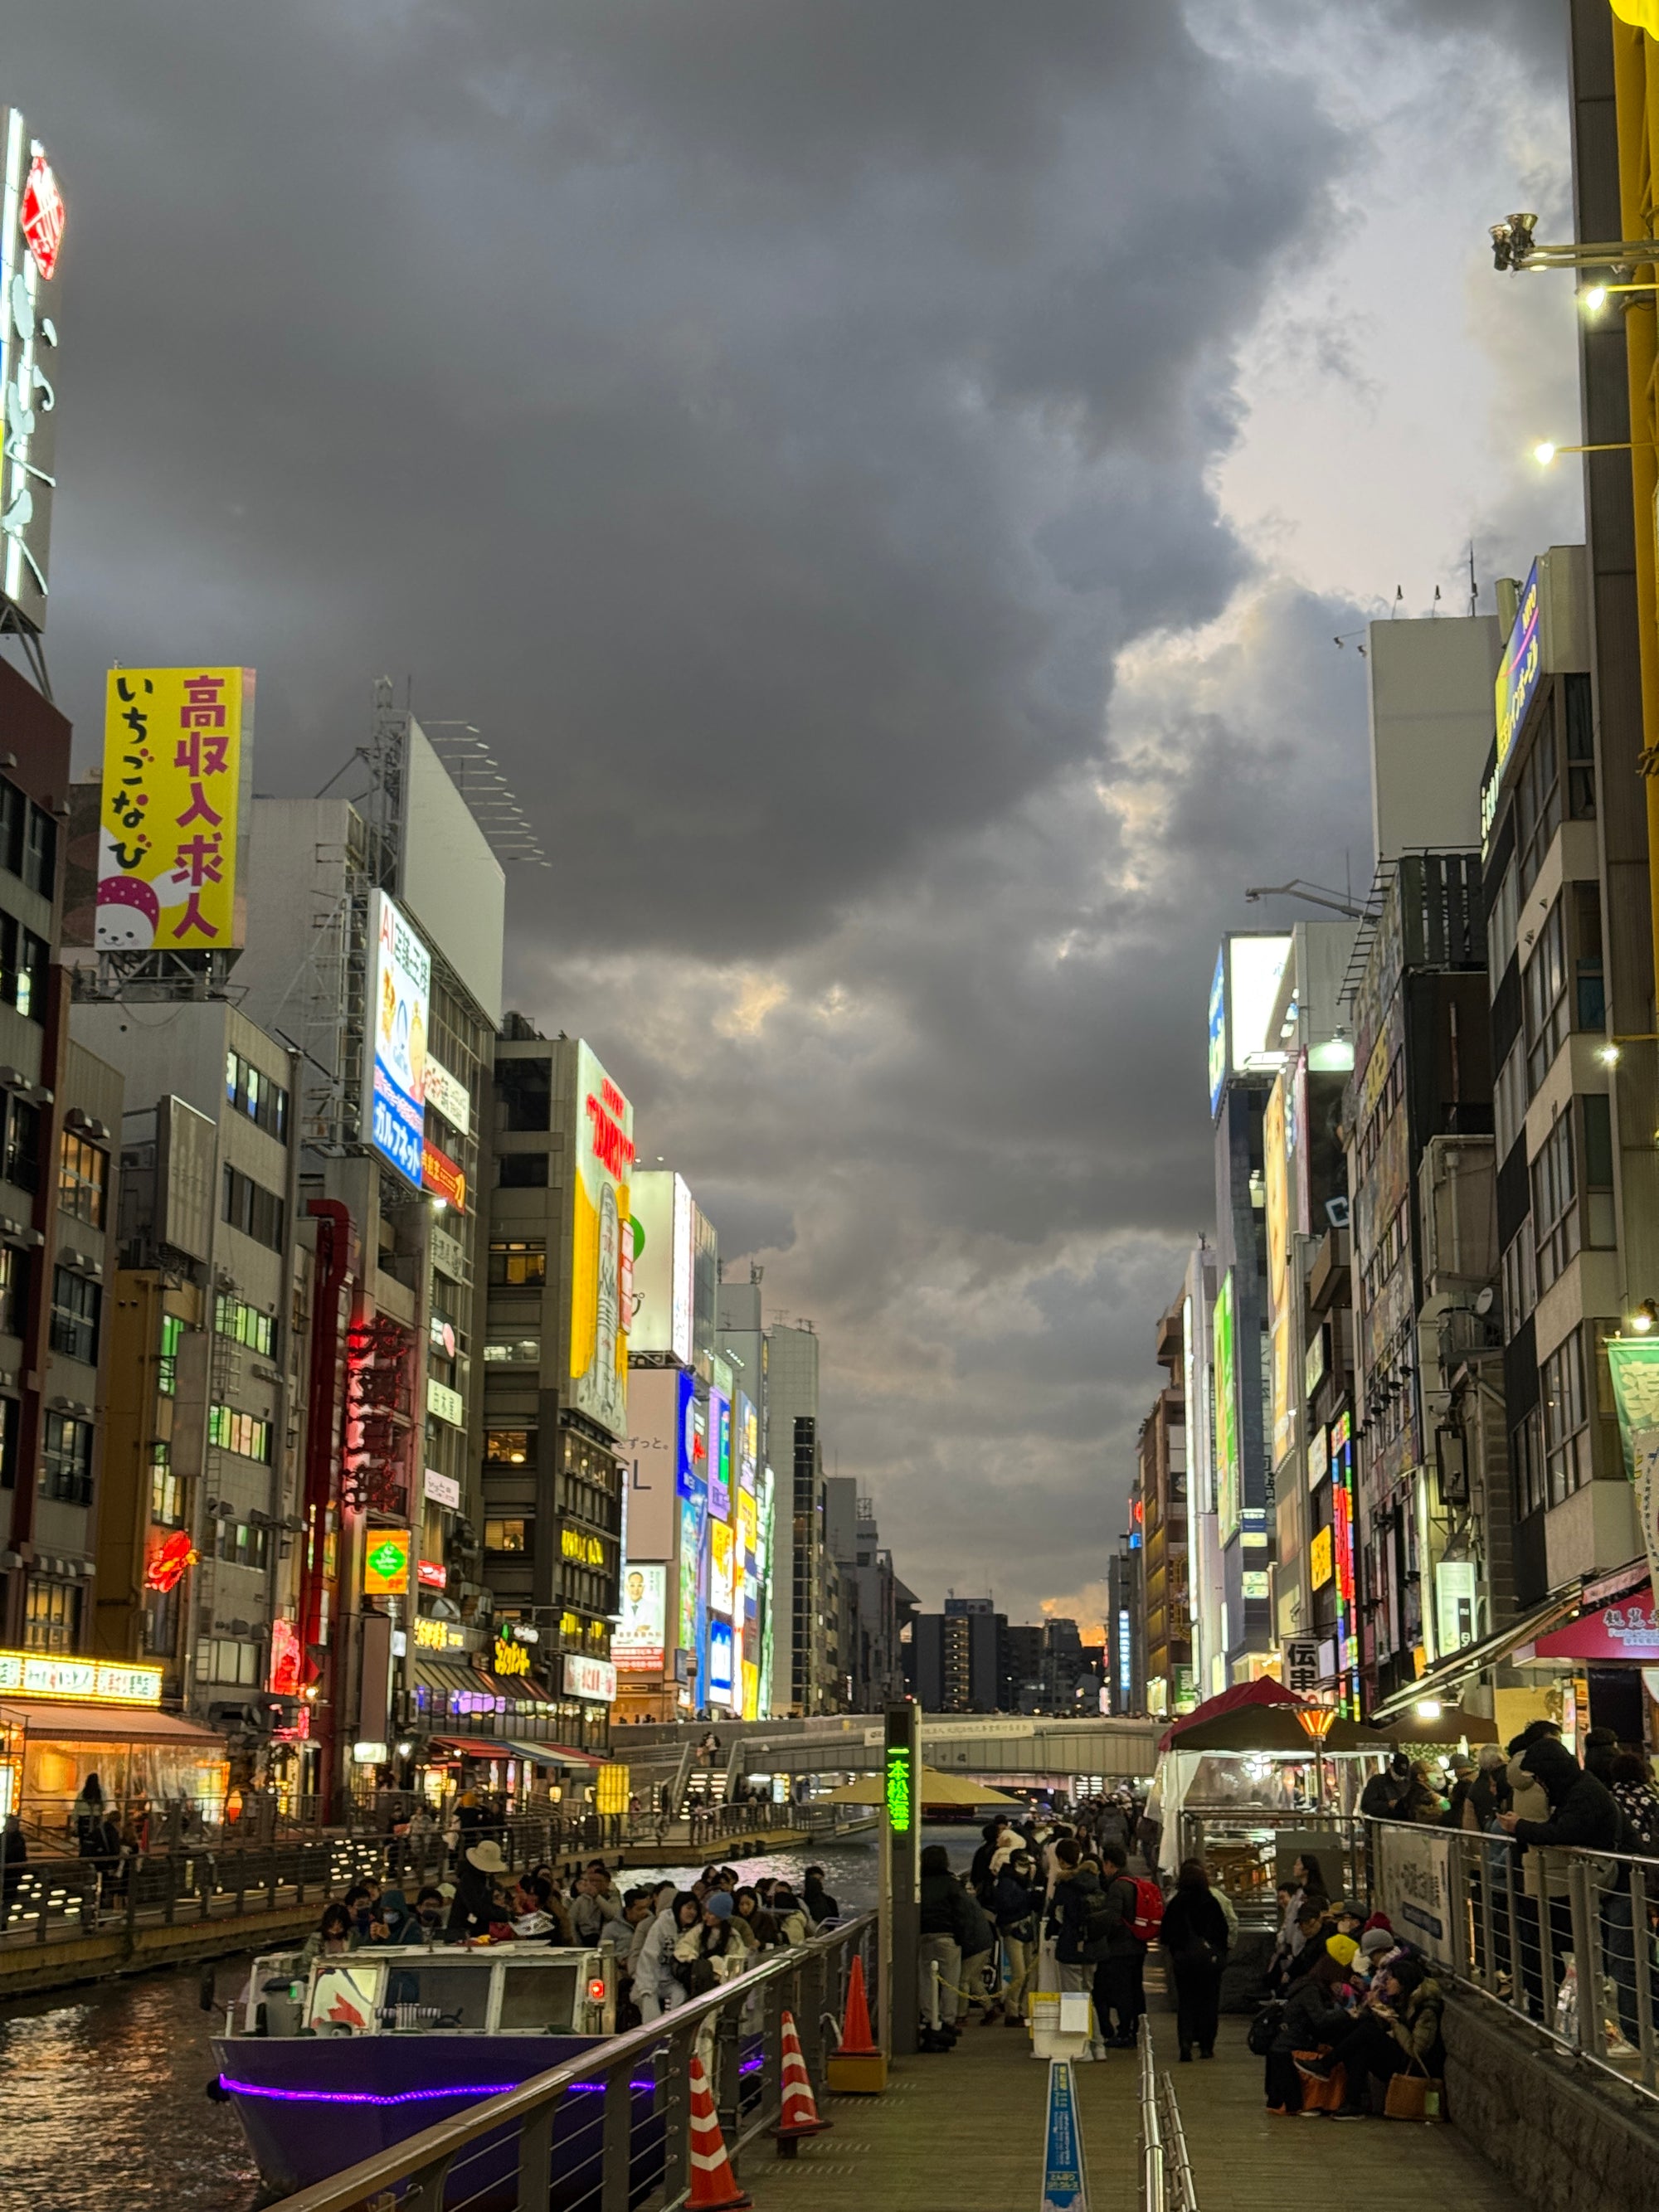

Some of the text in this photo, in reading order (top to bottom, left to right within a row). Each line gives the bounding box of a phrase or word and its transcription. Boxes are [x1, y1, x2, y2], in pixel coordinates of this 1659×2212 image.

[107, 677, 153, 869] いちごなび
[172, 674, 229, 939] 高収入求人
[374, 1101, 421, 1178] ガルフネット
[1287, 1644, 1316, 1692] 伝串
